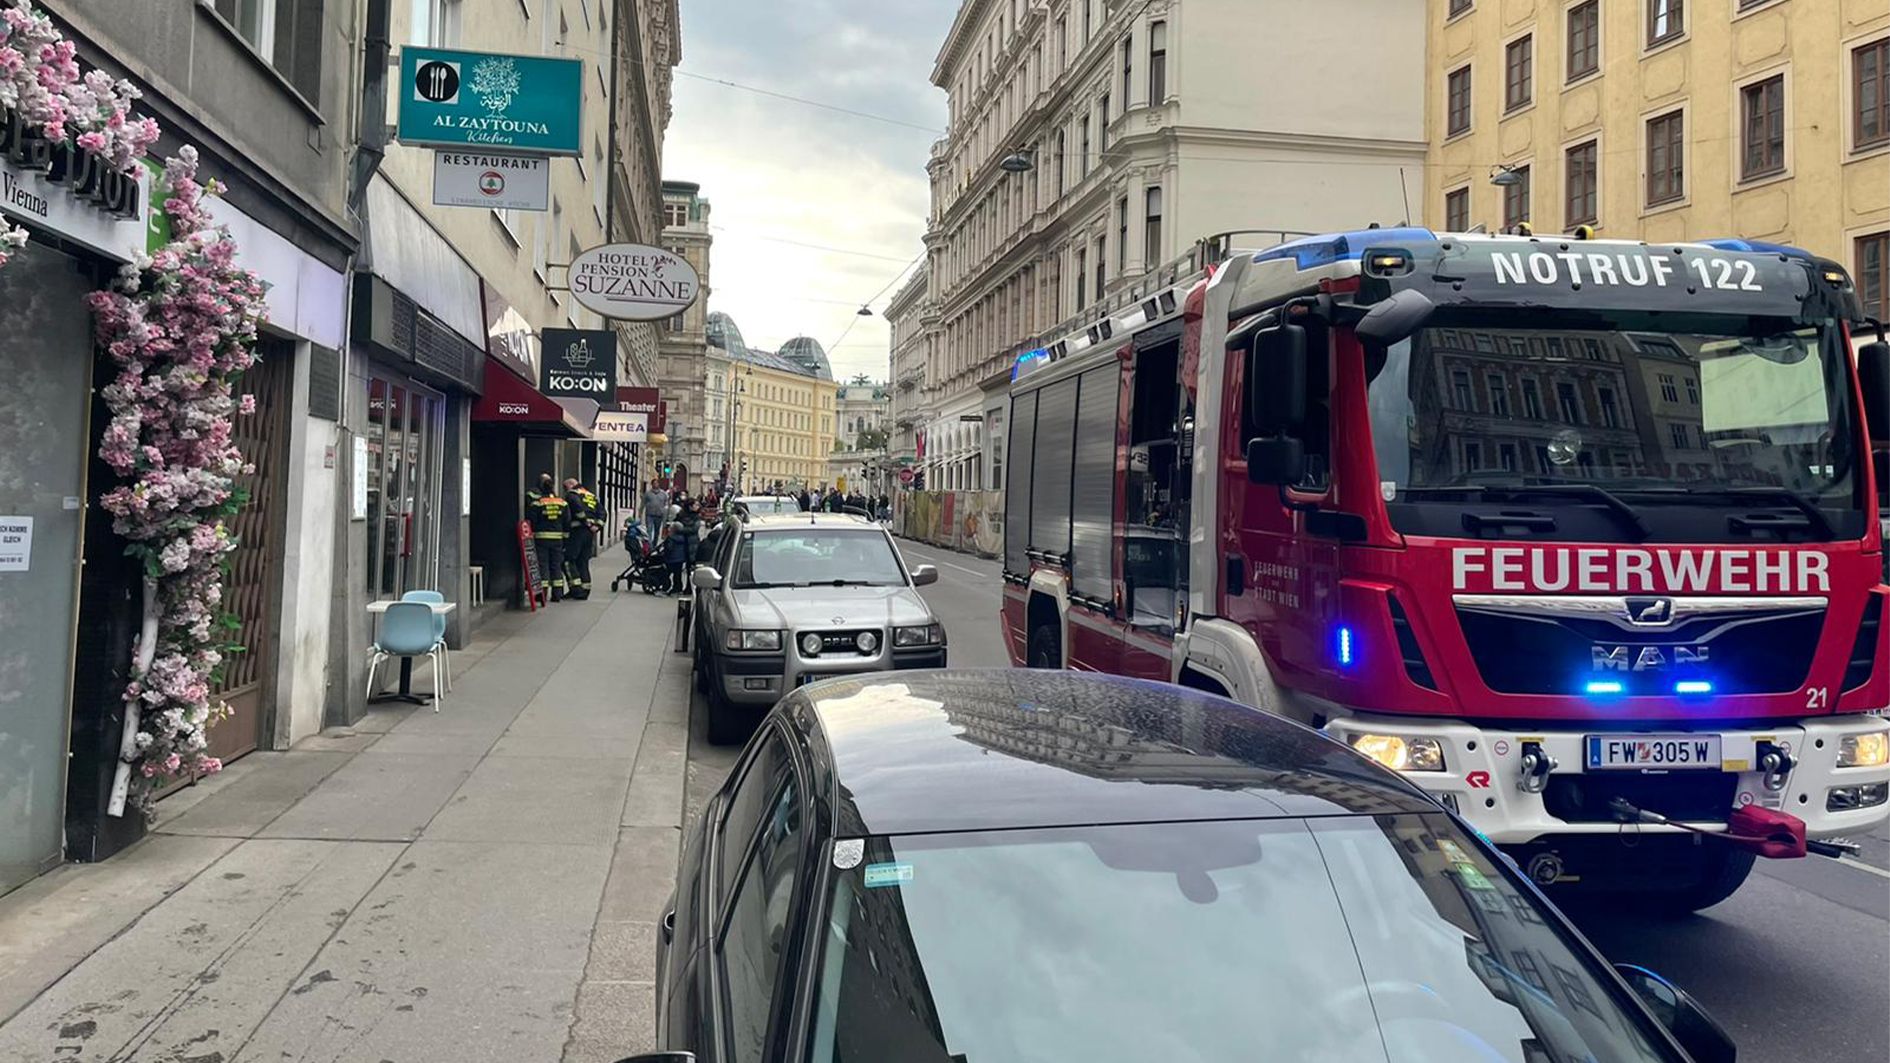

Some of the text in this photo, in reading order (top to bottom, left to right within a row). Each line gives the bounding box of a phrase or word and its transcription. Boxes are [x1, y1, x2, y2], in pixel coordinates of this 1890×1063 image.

[434, 115, 549, 134] AL ZAYTOUNA
[466, 129, 513, 144] Kitchen
[443, 154, 540, 170] RESTAURANT
[3, 171, 48, 217] Vienna
[599, 253, 648, 266] HOTEL
[581, 263, 648, 278] PENSION
[1491, 252, 1762, 291] NOTRUF 122
[575, 275, 690, 300] SUZANNE
[550, 376, 606, 392] KO:ON
[620, 401, 656, 412] Theater
[1253, 561, 1299, 580] FEUERWEHR
[1452, 547, 1831, 592] FEUERWEHR
[1254, 586, 1276, 602] STADT
[1591, 645, 1710, 672] MAN
[1806, 687, 1828, 708] 21
[1609, 742, 1708, 763] FW 305 W
